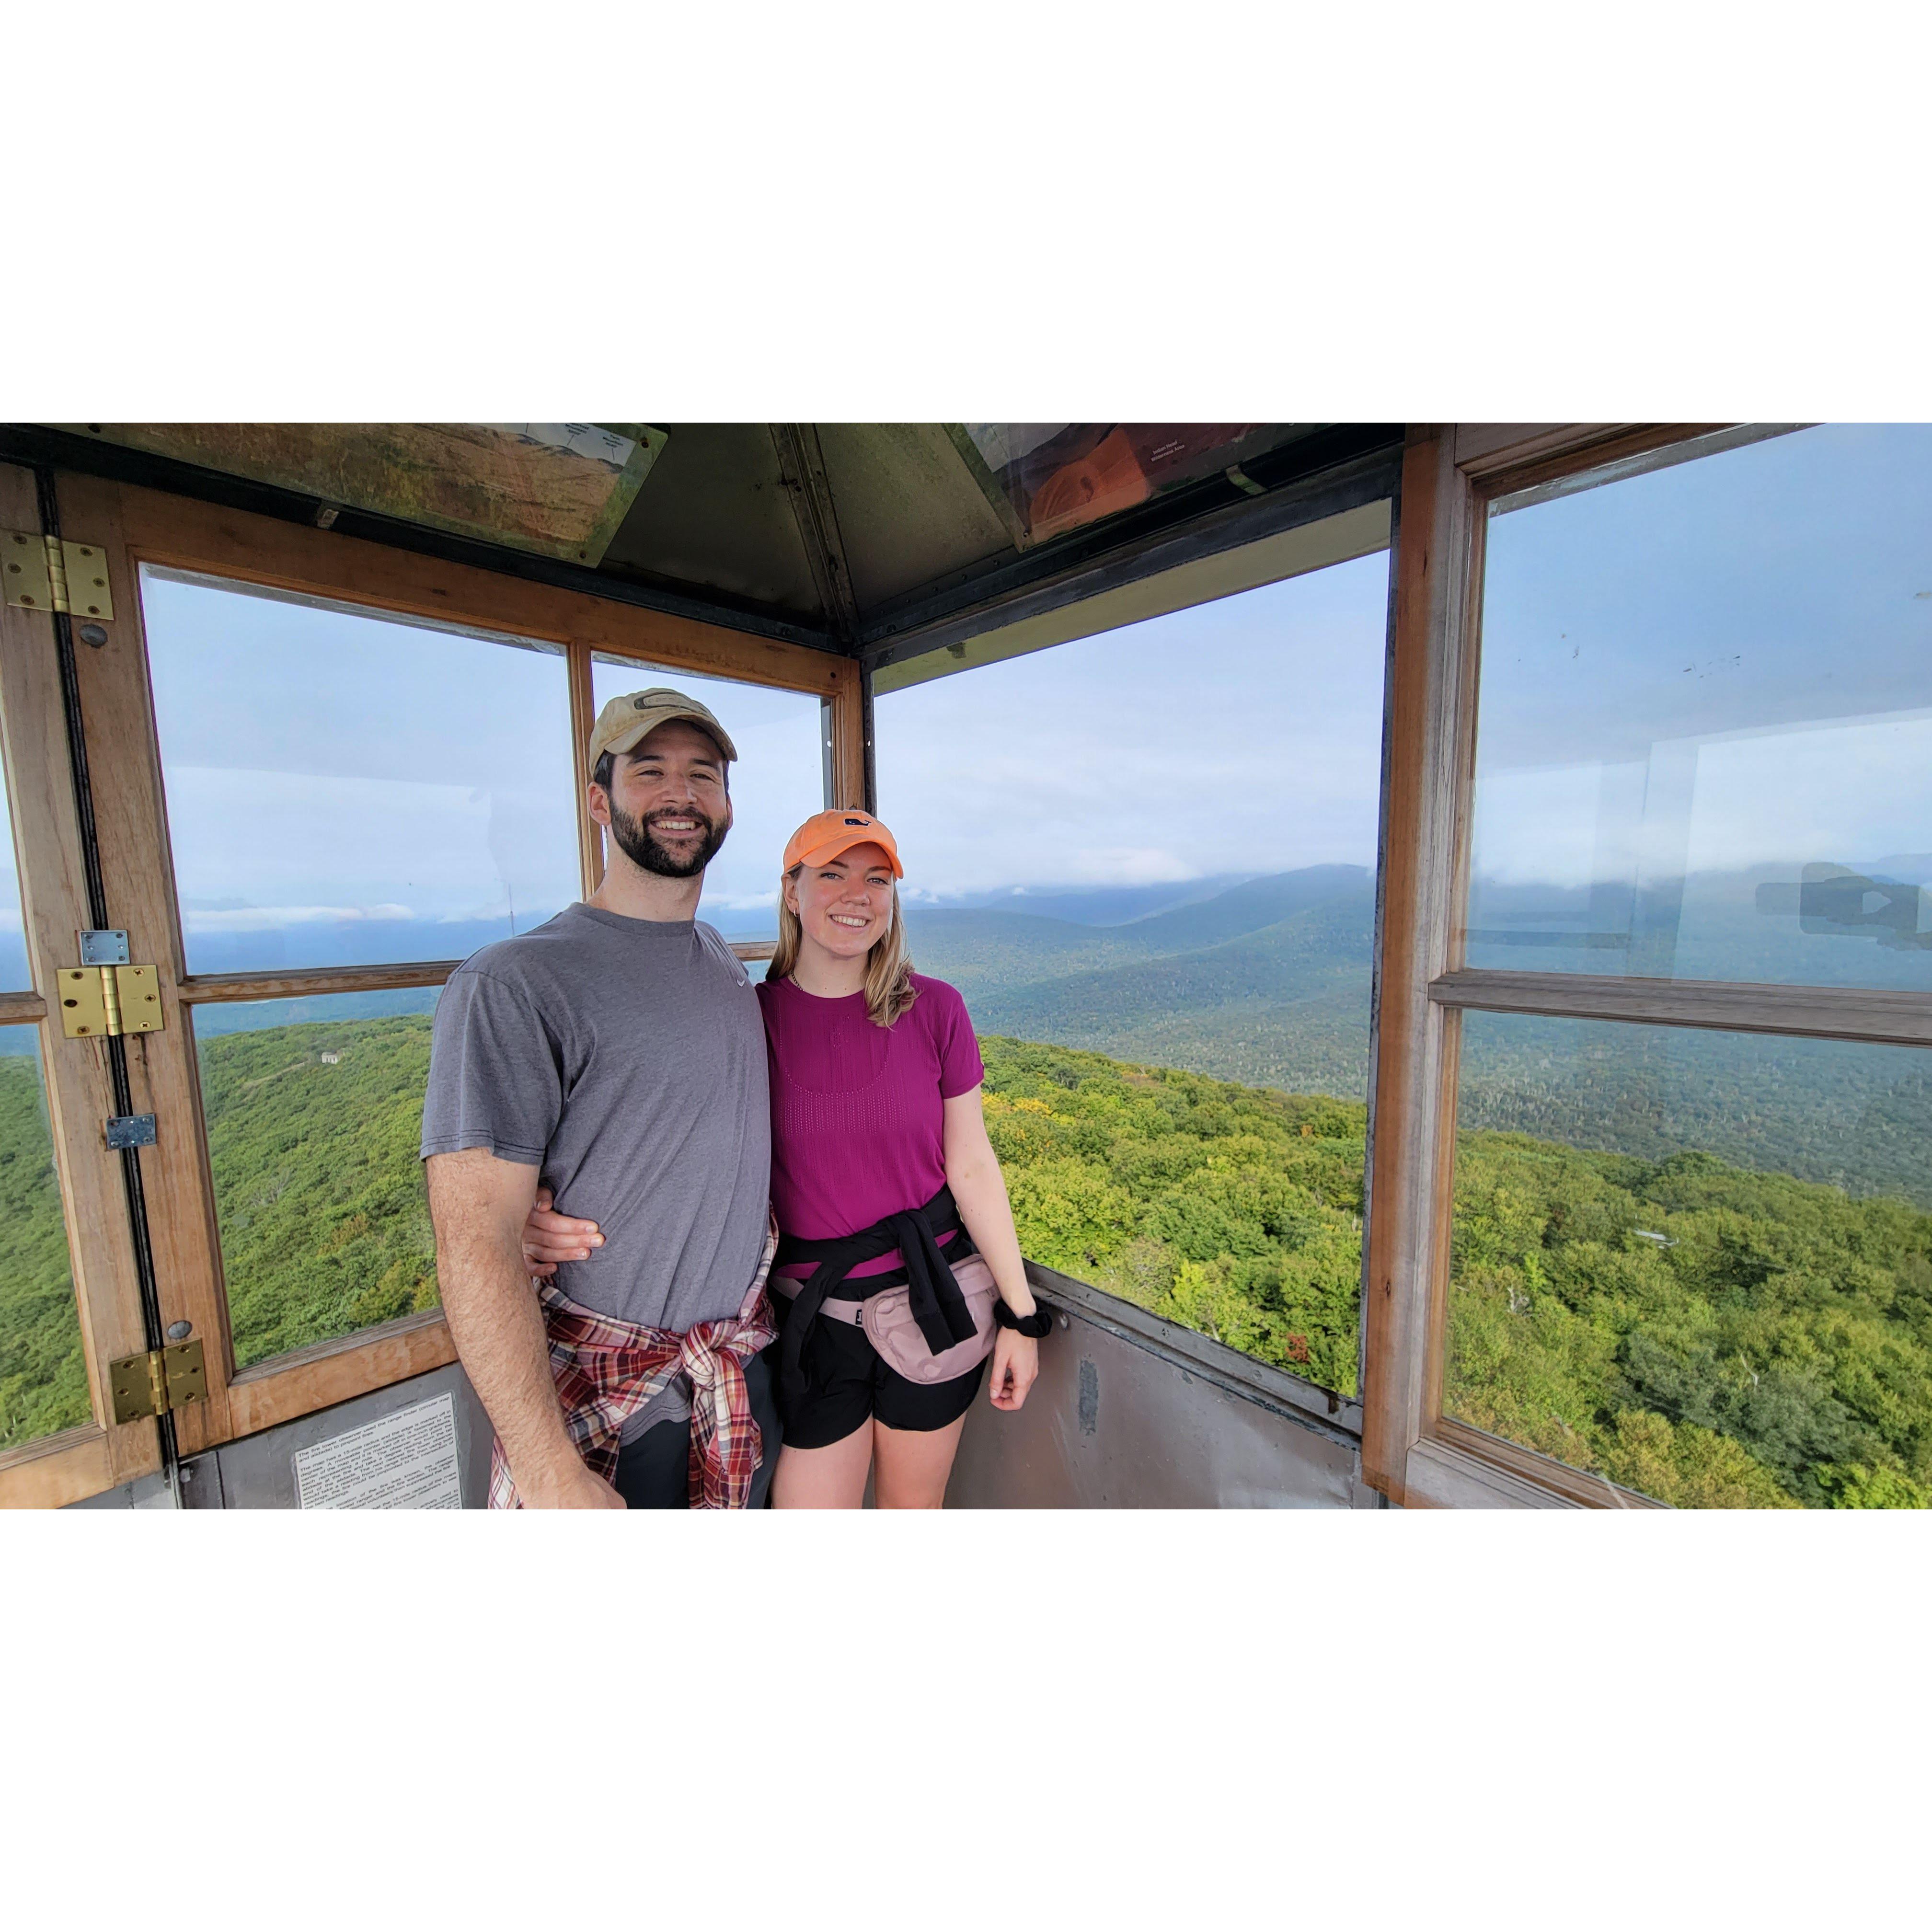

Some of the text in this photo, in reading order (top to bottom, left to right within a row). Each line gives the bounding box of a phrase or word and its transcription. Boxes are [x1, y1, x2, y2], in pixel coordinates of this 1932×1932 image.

[1150, 450, 1174, 461] Wilderness
[1152, 446, 1166, 455] Indian
[322, 1440, 336, 1449] tower
[339, 1431, 361, 1442] observer
[388, 1415, 402, 1423] range
[404, 1409, 417, 1417] finder
[364, 1438, 379, 1447] radius
[420, 1414, 437, 1424] marked
[341, 1435, 360, 1447] pinpoint
[301, 1473, 318, 1482] center
[373, 1442, 391, 1453] marked
[302, 1478, 315, 1487] each
[319, 1464, 352, 1480] representing
[390, 1440, 411, 1451] observer
[414, 1432, 428, 1441] would
[431, 1426, 442, 1435] point
[335, 1451, 360, 1463] moveable
[364, 1443, 380, 1453] pointer
[303, 1481, 322, 1492] alidade
[385, 1449, 402, 1458] degree
[404, 1440, 422, 1450] reading
[303, 1492, 319, 1501] would
[341, 1476, 360, 1486] reading
[385, 1460, 398, 1468] range
[353, 1477, 366, 1486] could
[336, 1496, 356, 1507] location
[357, 1494, 373, 1503] ranger
